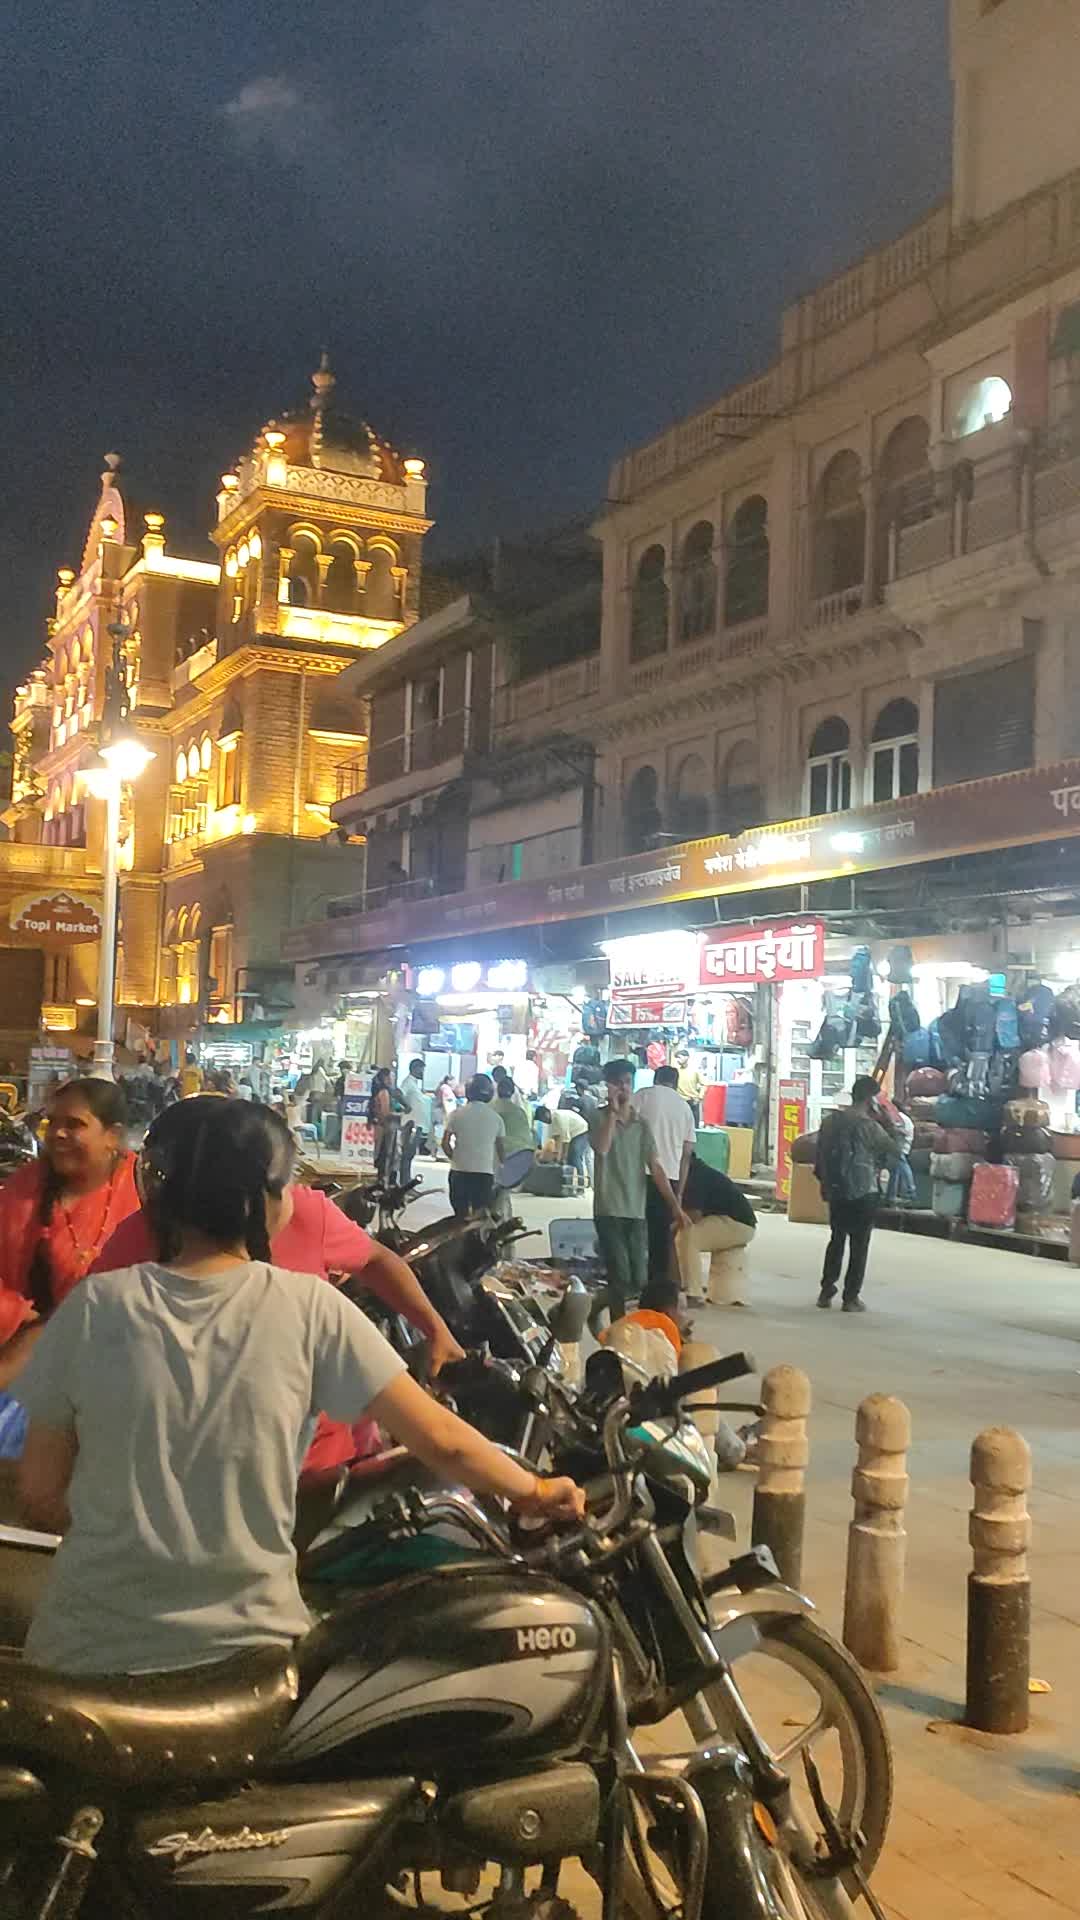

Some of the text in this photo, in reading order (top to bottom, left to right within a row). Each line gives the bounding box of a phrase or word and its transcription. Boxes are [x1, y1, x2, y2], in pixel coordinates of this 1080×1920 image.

[24, 919, 99, 933] Topi Market
[614, 970, 648, 987] SALE
[516, 1626, 577, 1651] Hero
